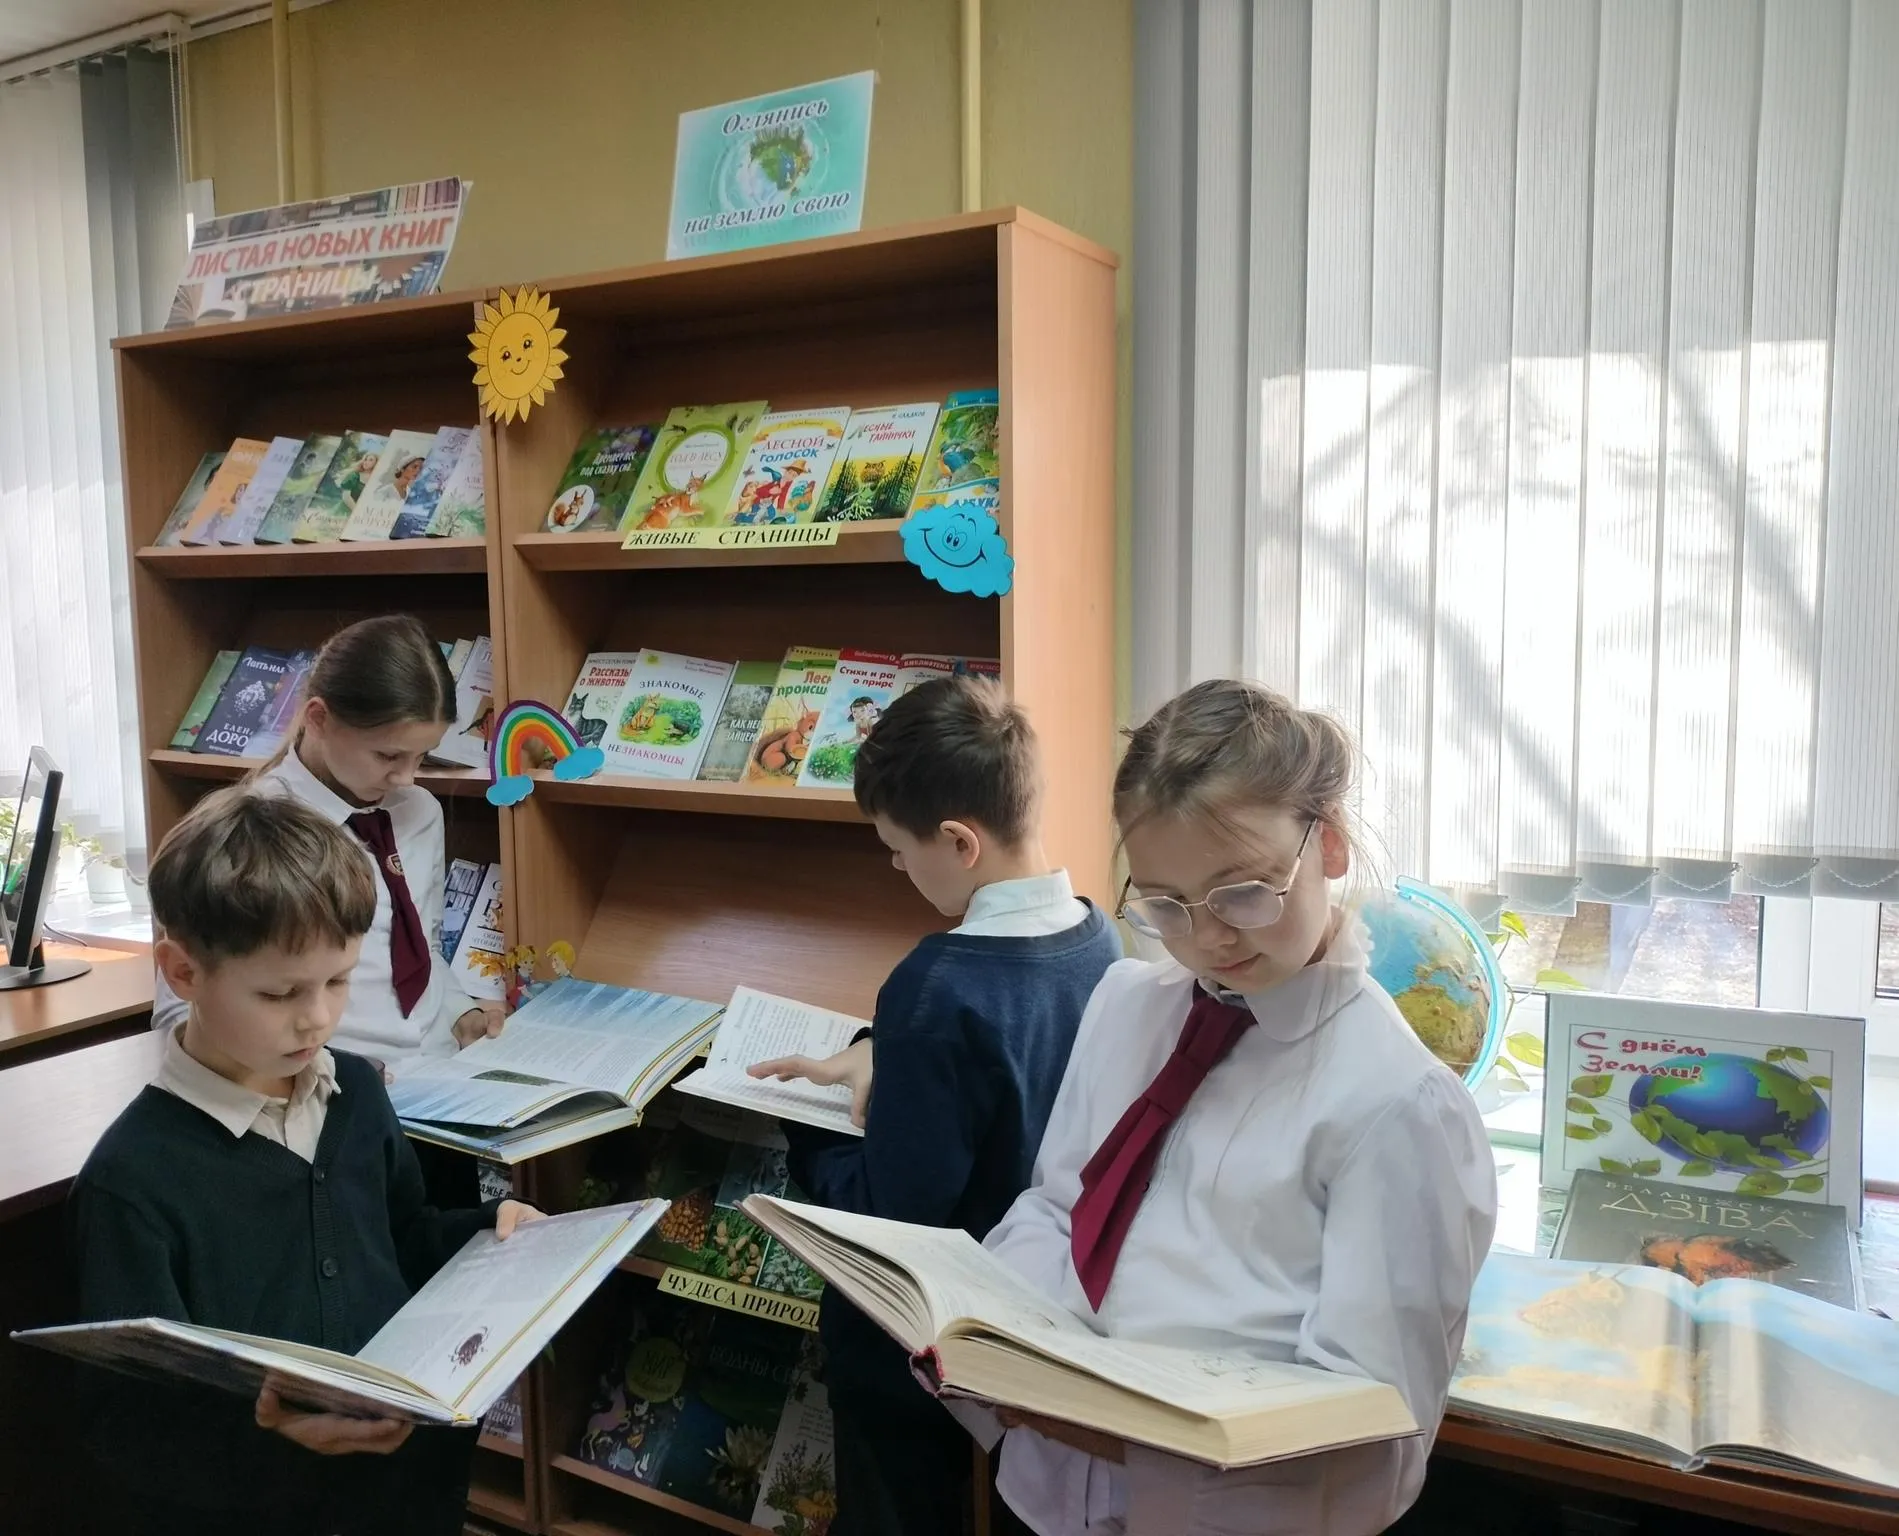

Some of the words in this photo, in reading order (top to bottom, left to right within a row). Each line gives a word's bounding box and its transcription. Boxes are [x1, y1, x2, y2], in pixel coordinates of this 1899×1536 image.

[723, 99, 828, 134] Оглянись
[684, 217, 710, 235] на
[714, 203, 786, 229] землю
[792, 192, 851, 215] свою
[187, 242, 277, 279] ЛИСТАЯ
[280, 226, 376, 264] НОВЫХ
[378, 215, 454, 250] КНИГ
[764, 435, 825, 450] ЛЕСНОЙ
[760, 448, 819, 463] ГОЛОСОК
[628, 531, 700, 546] ЖИВЫЕ
[718, 527, 831, 546] СТРАНИЦЫ
[839, 666, 868, 677] Стихи
[639, 679, 706, 699] ЗНАКОМЫЕ
[730, 719, 748, 729] КАК
[607, 743, 686, 766] НЕЗНАКОМЦЫ
[1576, 1031, 1610, 1051] С
[1620, 1038, 1707, 1058] днём
[1578, 1053, 1702, 1079] Земли!
[1600, 1190, 1815, 1241] ДЗІВА
[668, 1273, 737, 1307] ЧУДЕСА
[741, 1293, 820, 1328] ПРИРОД
